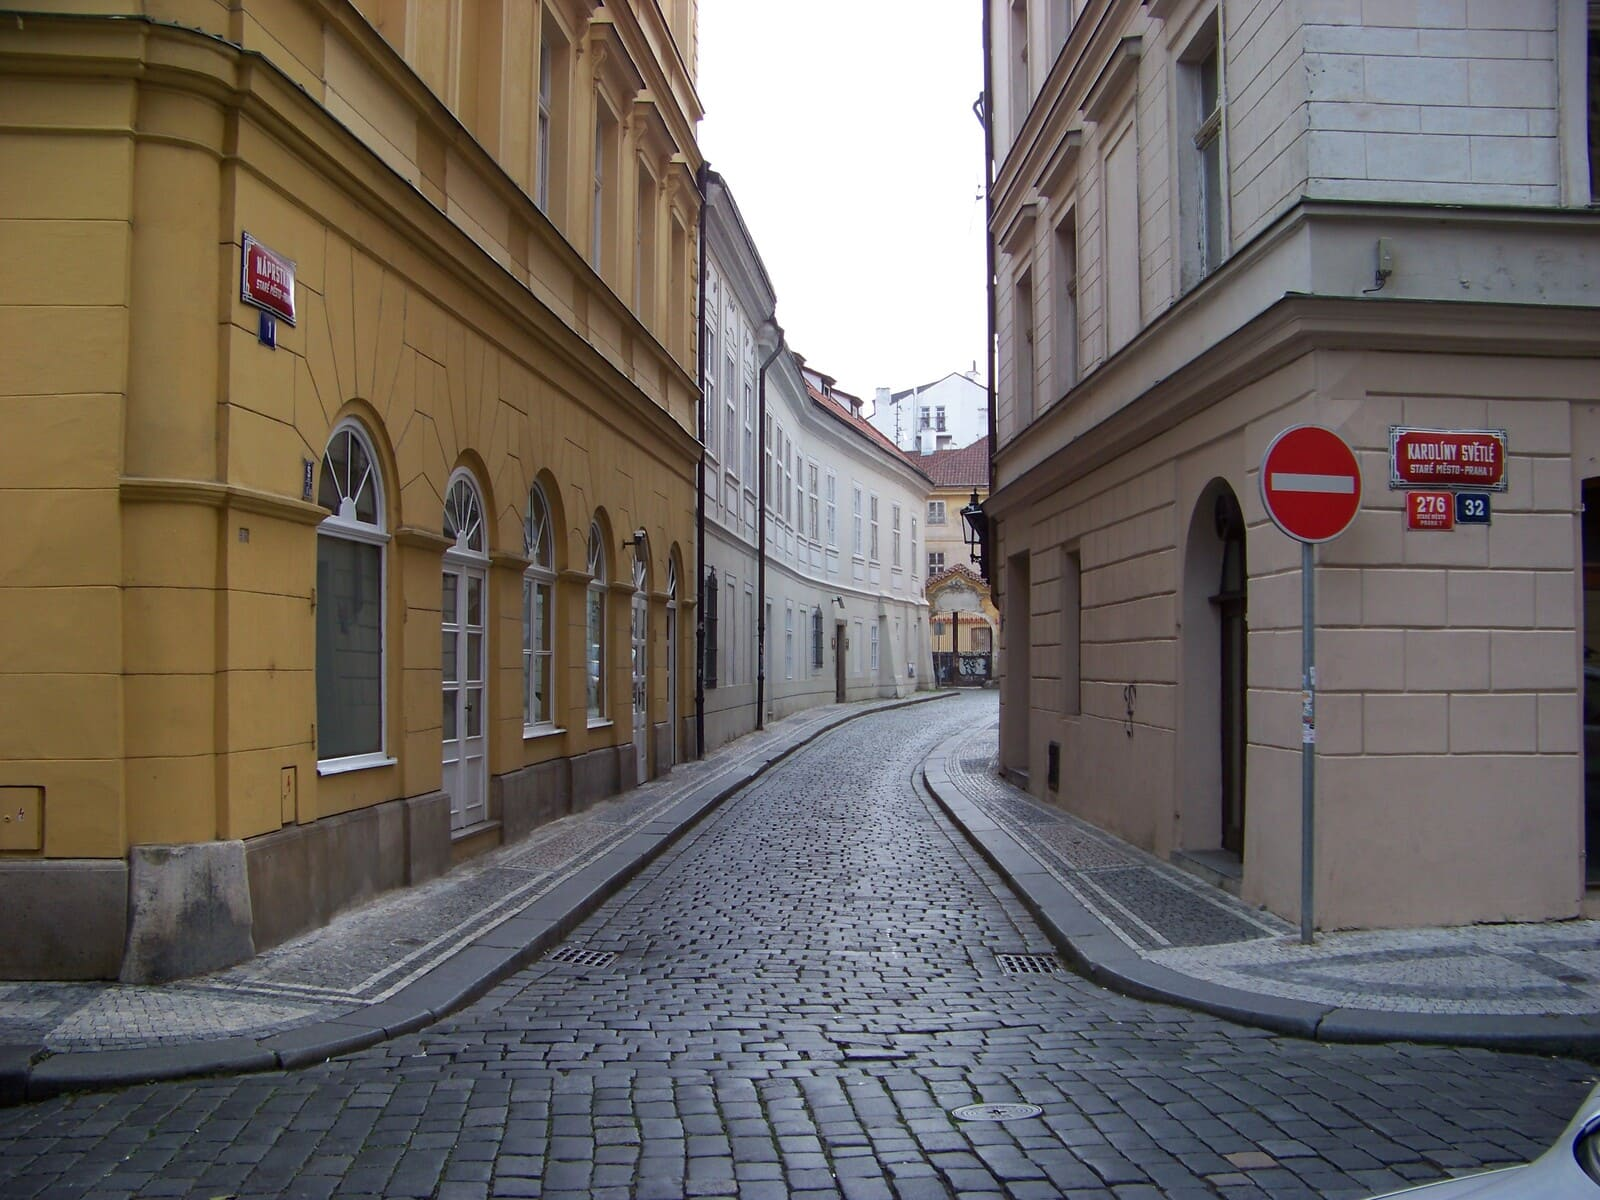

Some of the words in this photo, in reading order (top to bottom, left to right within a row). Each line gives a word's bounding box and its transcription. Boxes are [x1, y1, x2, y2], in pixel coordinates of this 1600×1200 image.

[268, 320, 272, 338] 1
[1407, 440, 1457, 461] KAROLÍNY
[1461, 441, 1495, 463] SVĚTLÉ
[1410, 462, 1434, 474] STARÉ
[1416, 496, 1446, 513] 276
[1465, 499, 1484, 516] 32
